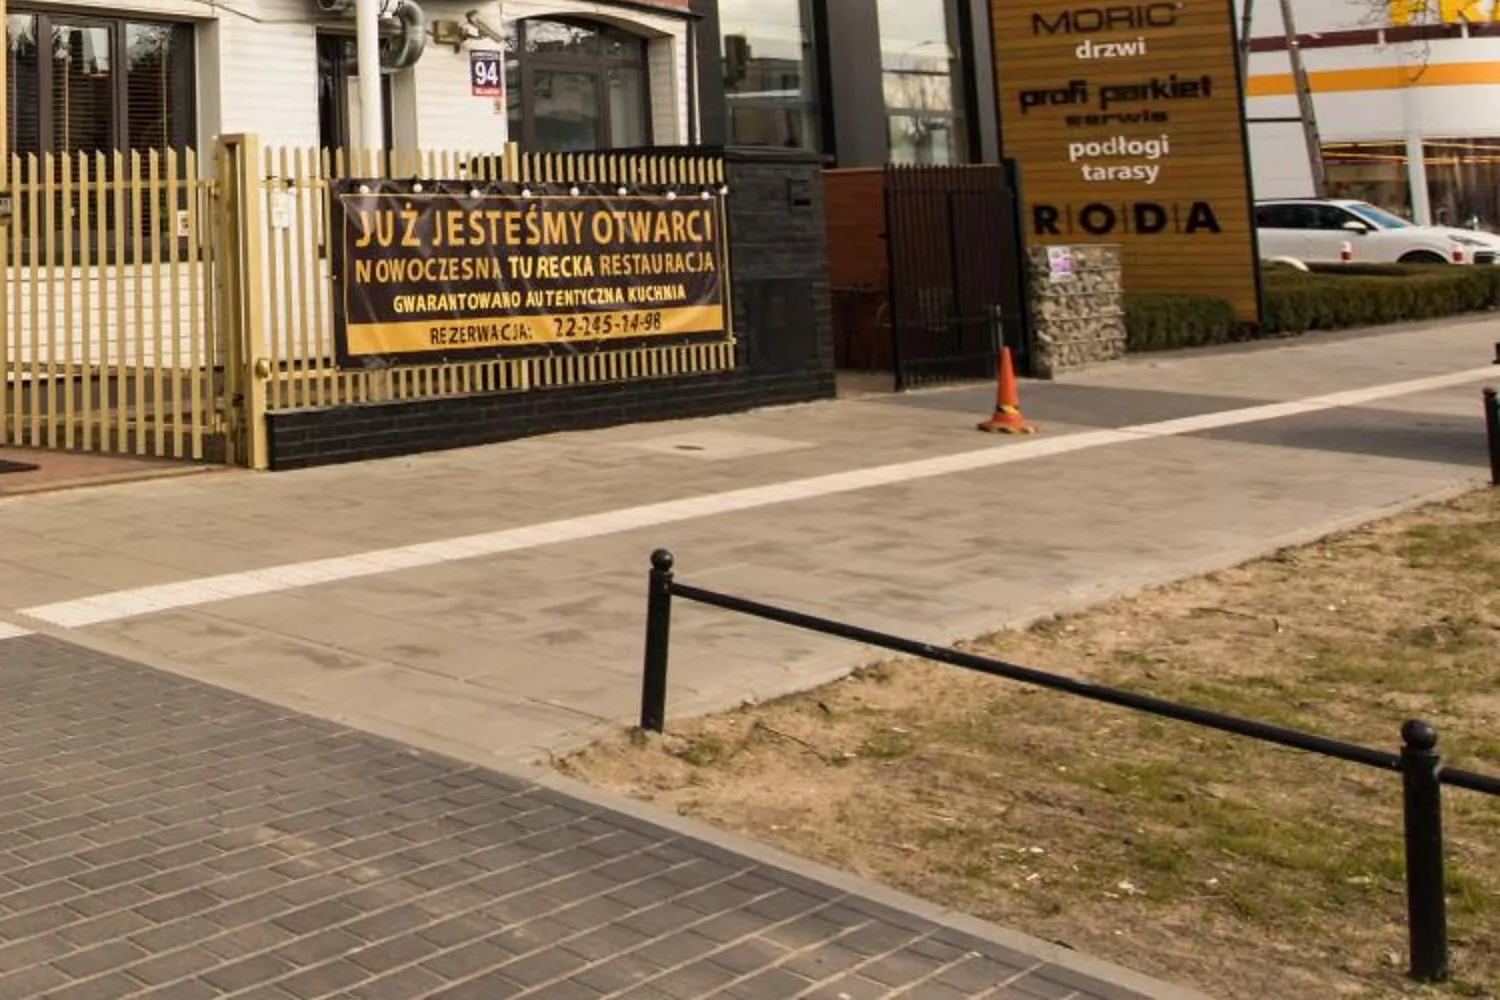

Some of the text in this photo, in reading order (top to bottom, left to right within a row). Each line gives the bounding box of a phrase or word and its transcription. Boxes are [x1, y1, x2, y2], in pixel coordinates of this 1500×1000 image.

[1031, 2, 1179, 36] MORIC
[1075, 37, 1146, 60] drzwi
[475, 61, 498, 85] 94
[1018, 73, 1212, 115] profi parkiet
[1064, 109, 1169, 127] serwis
[1068, 133, 1170, 162] podłogi
[1081, 163, 1160, 185] tarasy
[355, 202, 712, 248] JUŻ JESTEŚMY OTWARCI
[355, 251, 715, 284] NOWOCZESNA TURECKA RESTAURACJA
[393, 283, 687, 314] GWARANTOWANO AUTENTYCZNA KUCHNIA
[430, 323, 533, 345] REZERWACJA:
